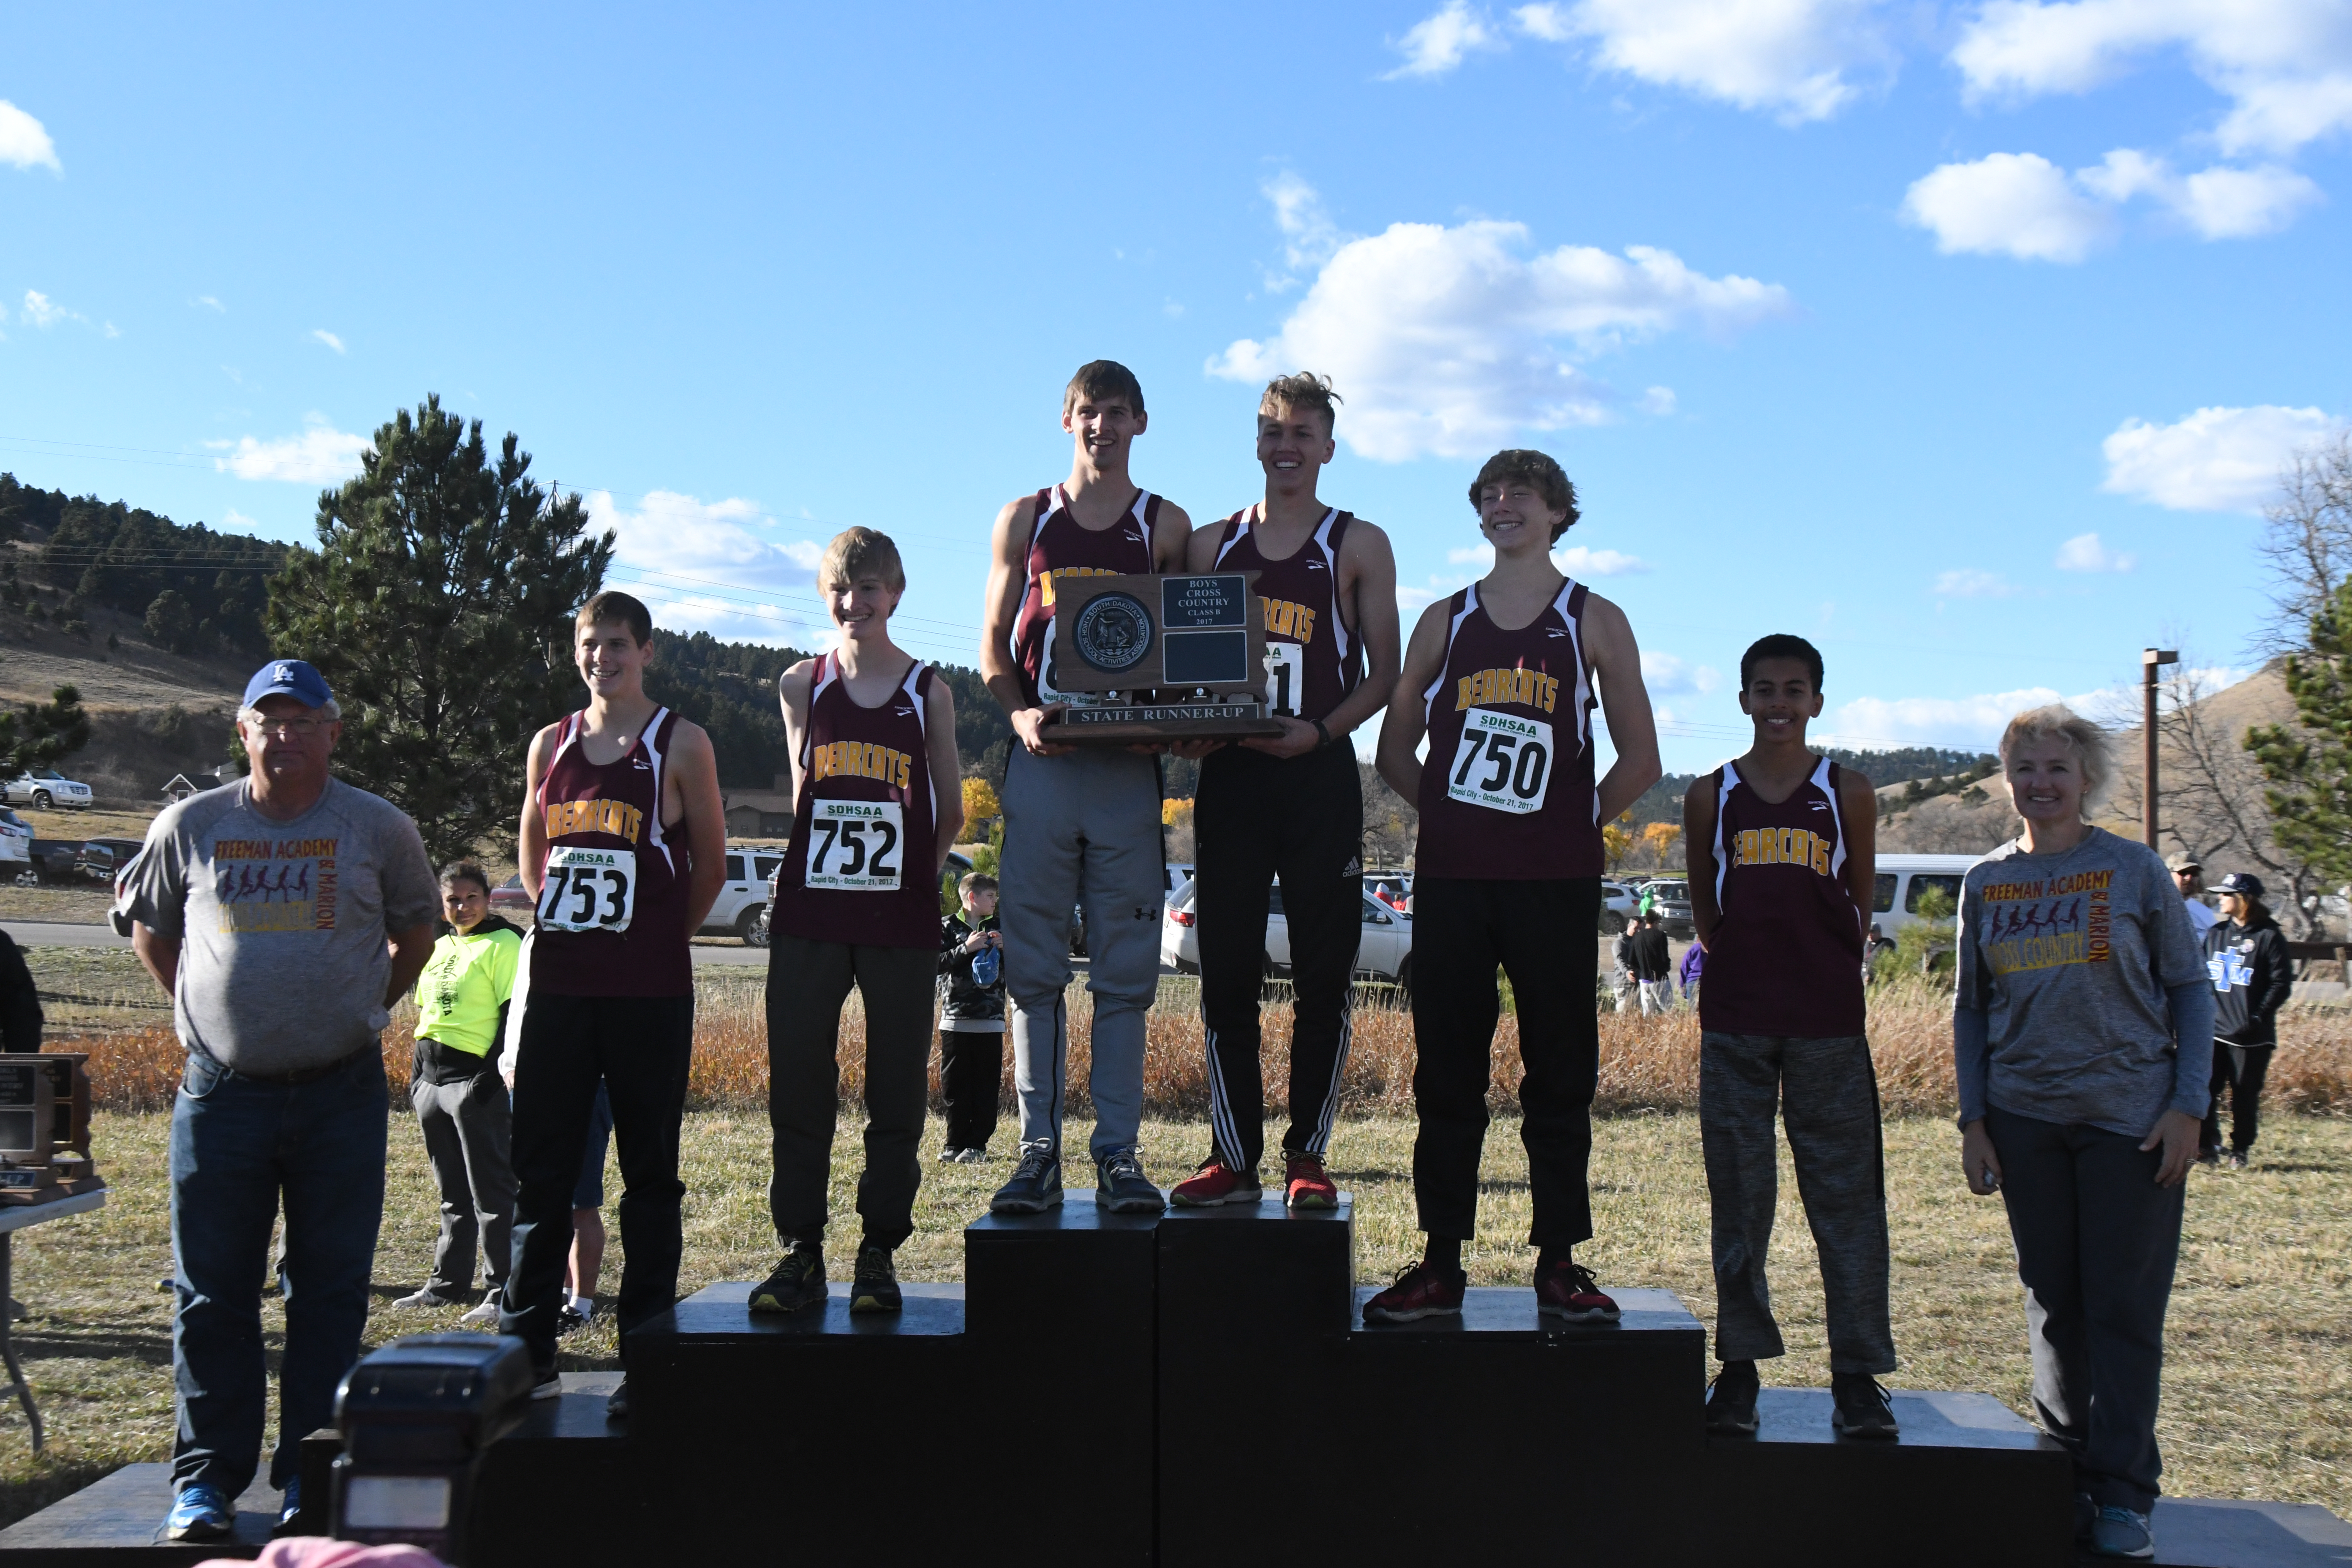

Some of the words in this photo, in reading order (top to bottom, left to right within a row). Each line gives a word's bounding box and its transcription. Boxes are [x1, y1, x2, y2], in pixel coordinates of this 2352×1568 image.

[1187, 589, 1221, 597] CROSS
[1190, 580, 1217, 588] BOYS
[1089, 601, 1110, 617] SOUTH
[1113, 601, 1138, 615] DAKOTA
[1178, 598, 1229, 607] COUNTRY
[1082, 637, 1098, 659] SCHOOL
[1099, 654, 1131, 664] ACTIVITIES
[1131, 618, 1146, 657] ASSOCIATION
[273, 664, 294, 682] LA
[1044, 693, 1059, 701] Rapid
[1060, 694, 1072, 703] City
[1078, 697, 1099, 705] October
[1455, 668, 1559, 713] BEARCATS
[1081, 710, 1134, 722] STATE
[1143, 707, 1244, 720] RUNNER-UP
[1480, 715, 1536, 735] SDHSAA
[814, 741, 912, 789] BEARCATS
[1454, 728, 1547, 799] 750
[1451, 786, 1465, 796] Rapid
[1467, 789, 1477, 799] City
[1483, 793, 1506, 804] October
[1507, 799, 1516, 808] 21,
[1518, 801, 1534, 811] 2017
[828, 805, 882, 816] SDHSAA
[546, 798, 643, 844] BEARCATS
[215, 840, 272, 860] FREEMAN
[275, 839, 338, 859] ACADEMY
[812, 819, 896, 876] 752
[811, 876, 827, 884] Rapid
[828, 877, 839, 885] City
[1342, 868, 1363, 877] adidas
[544, 867, 628, 924] 753
[1983, 880, 2044, 902] FREEMAN
[2047, 870, 2115, 896] ACADEMY
[2091, 891, 2108, 901] &
[317, 874, 338, 929] MARION
[2089, 905, 2111, 962] MARION
